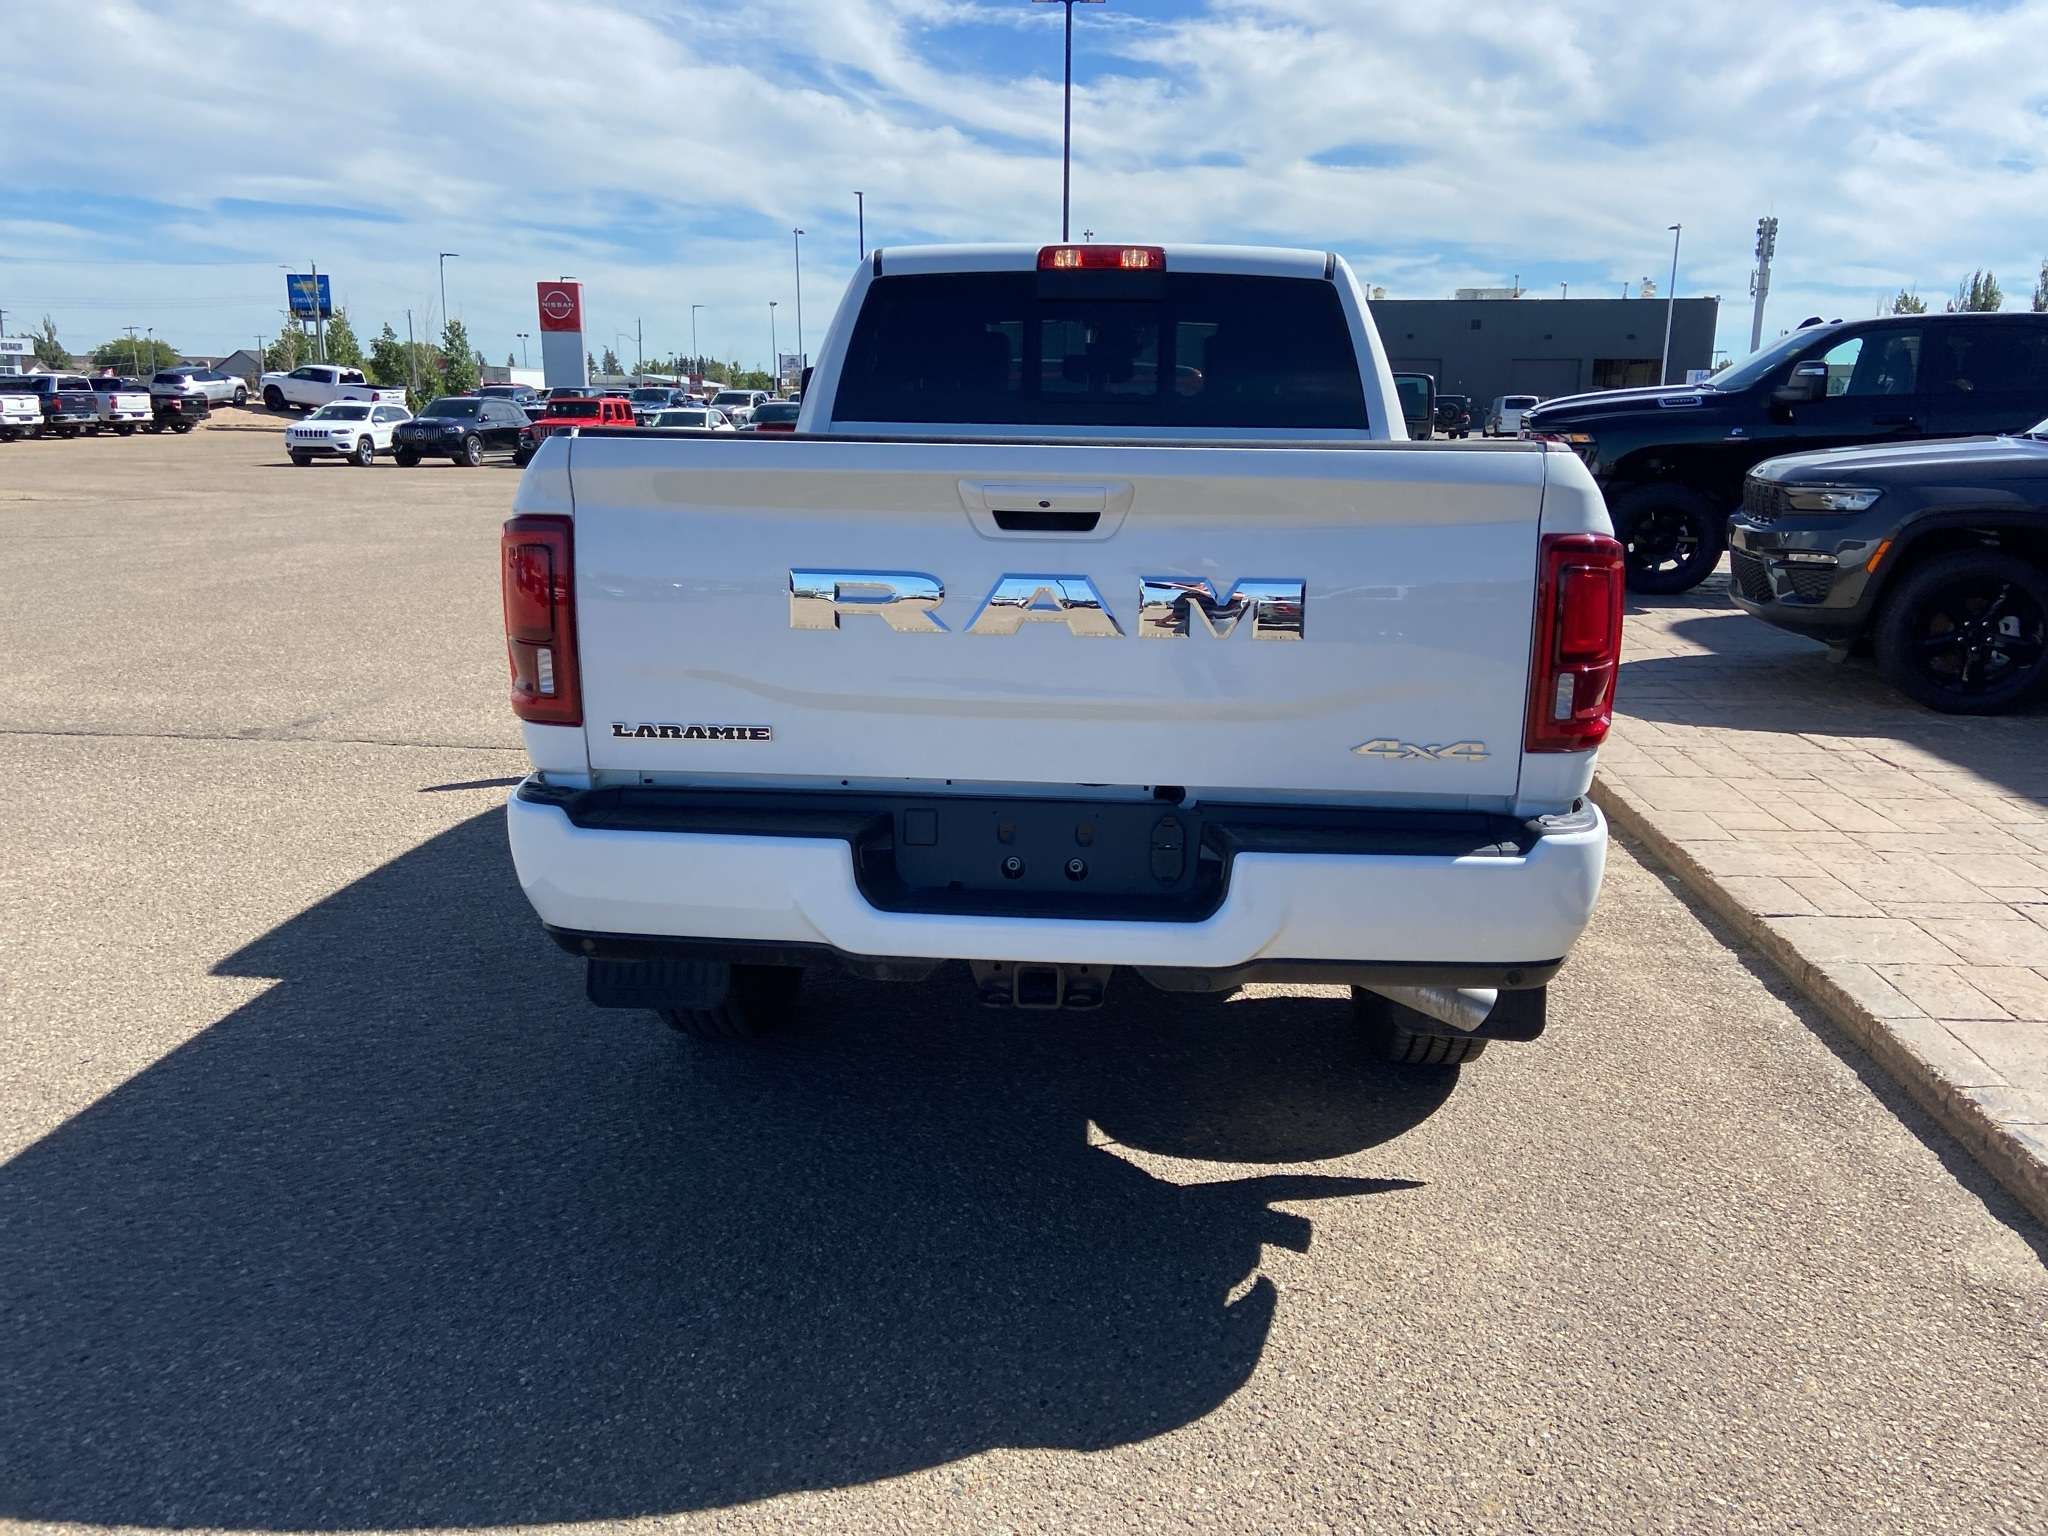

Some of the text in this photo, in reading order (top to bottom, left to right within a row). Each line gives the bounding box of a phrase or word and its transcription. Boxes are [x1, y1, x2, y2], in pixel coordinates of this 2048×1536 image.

[541, 301, 574, 309] NISSAN
[789, 567, 1306, 641] RAM
[610, 722, 773, 743] LARAMIE
